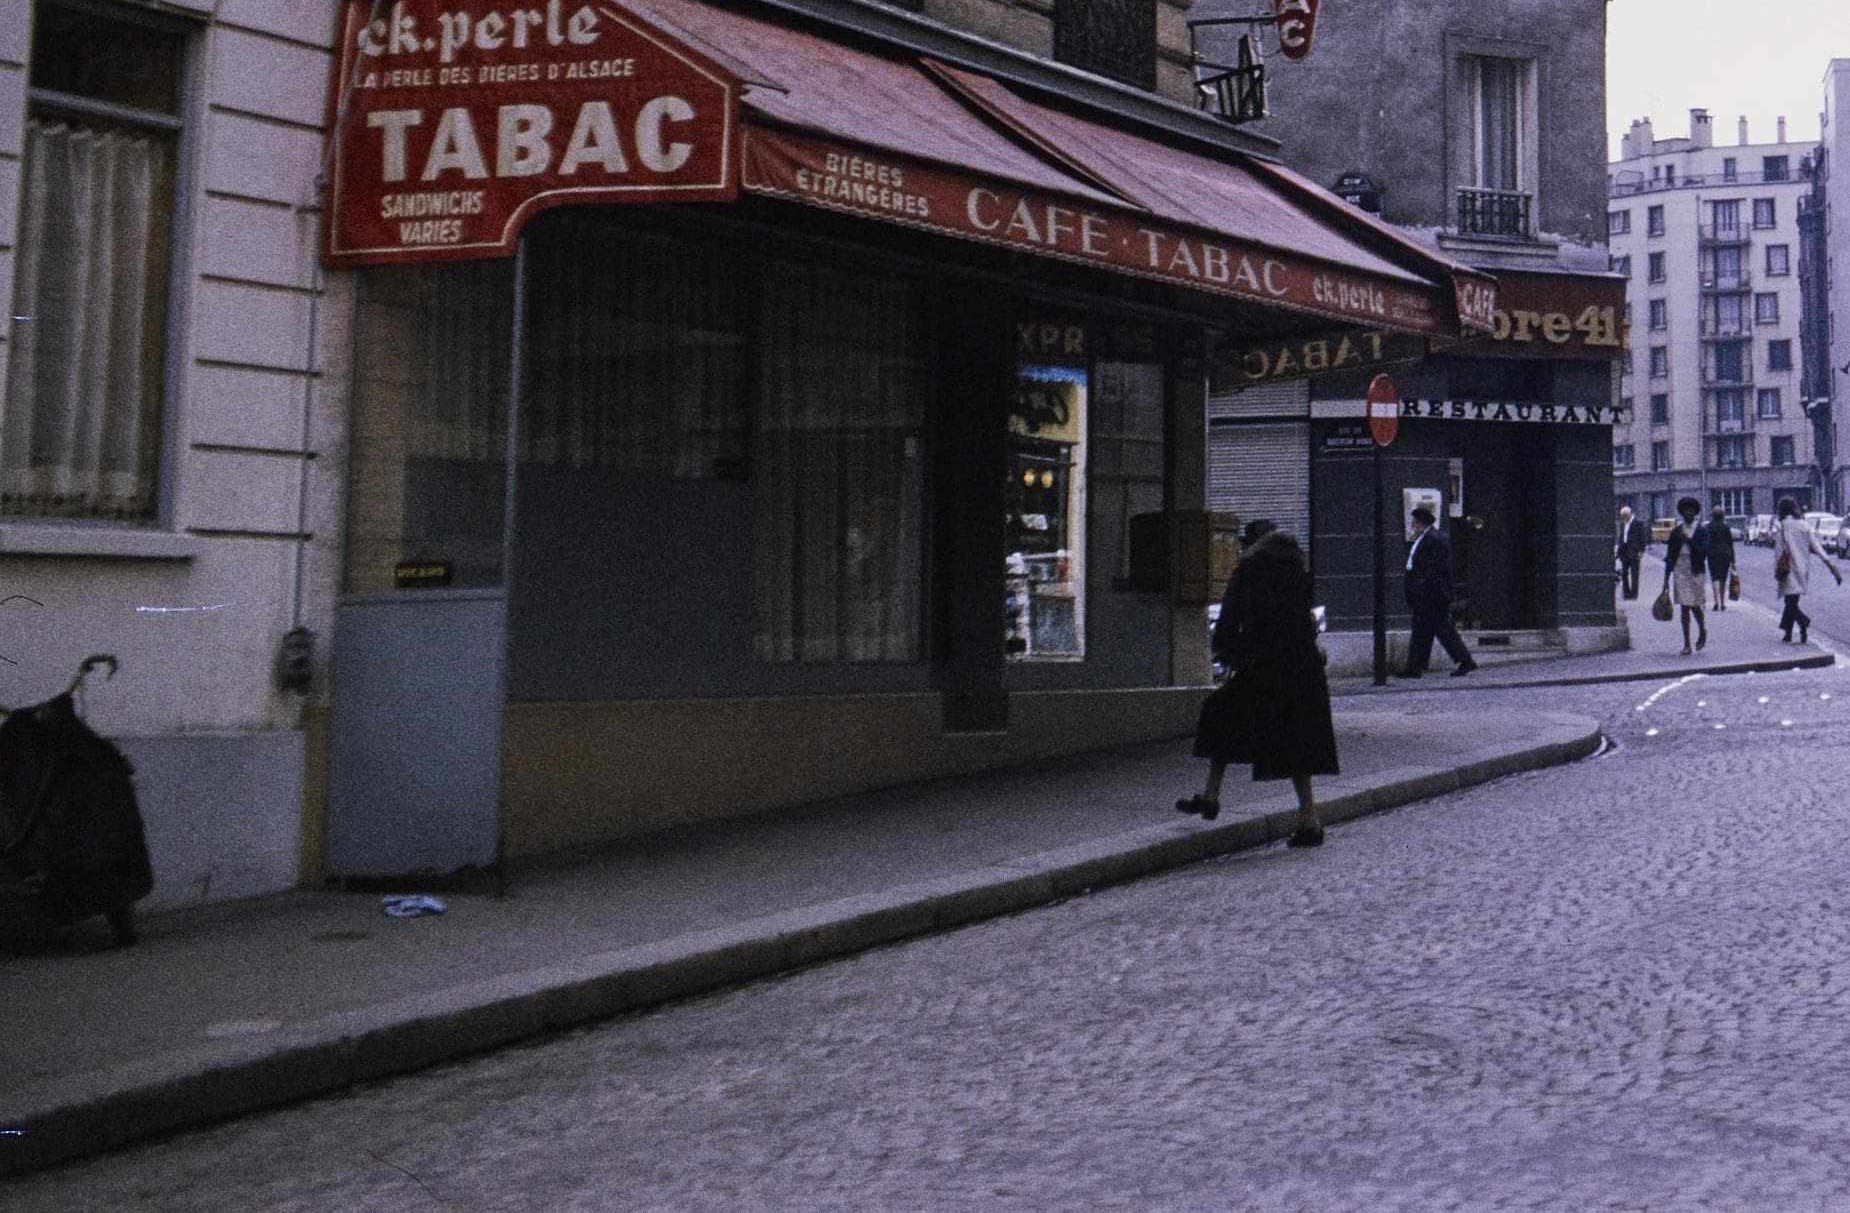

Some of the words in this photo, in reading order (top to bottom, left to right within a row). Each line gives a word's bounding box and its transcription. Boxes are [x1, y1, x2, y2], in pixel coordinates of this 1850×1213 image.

[440, 65, 470, 84] DES
[366, 95, 697, 183] TABAC
[381, 191, 484, 220] SANDWICHS
[1140, 228, 1289, 296] TABAC
[1401, 398, 1625, 425] RESTAURANT
